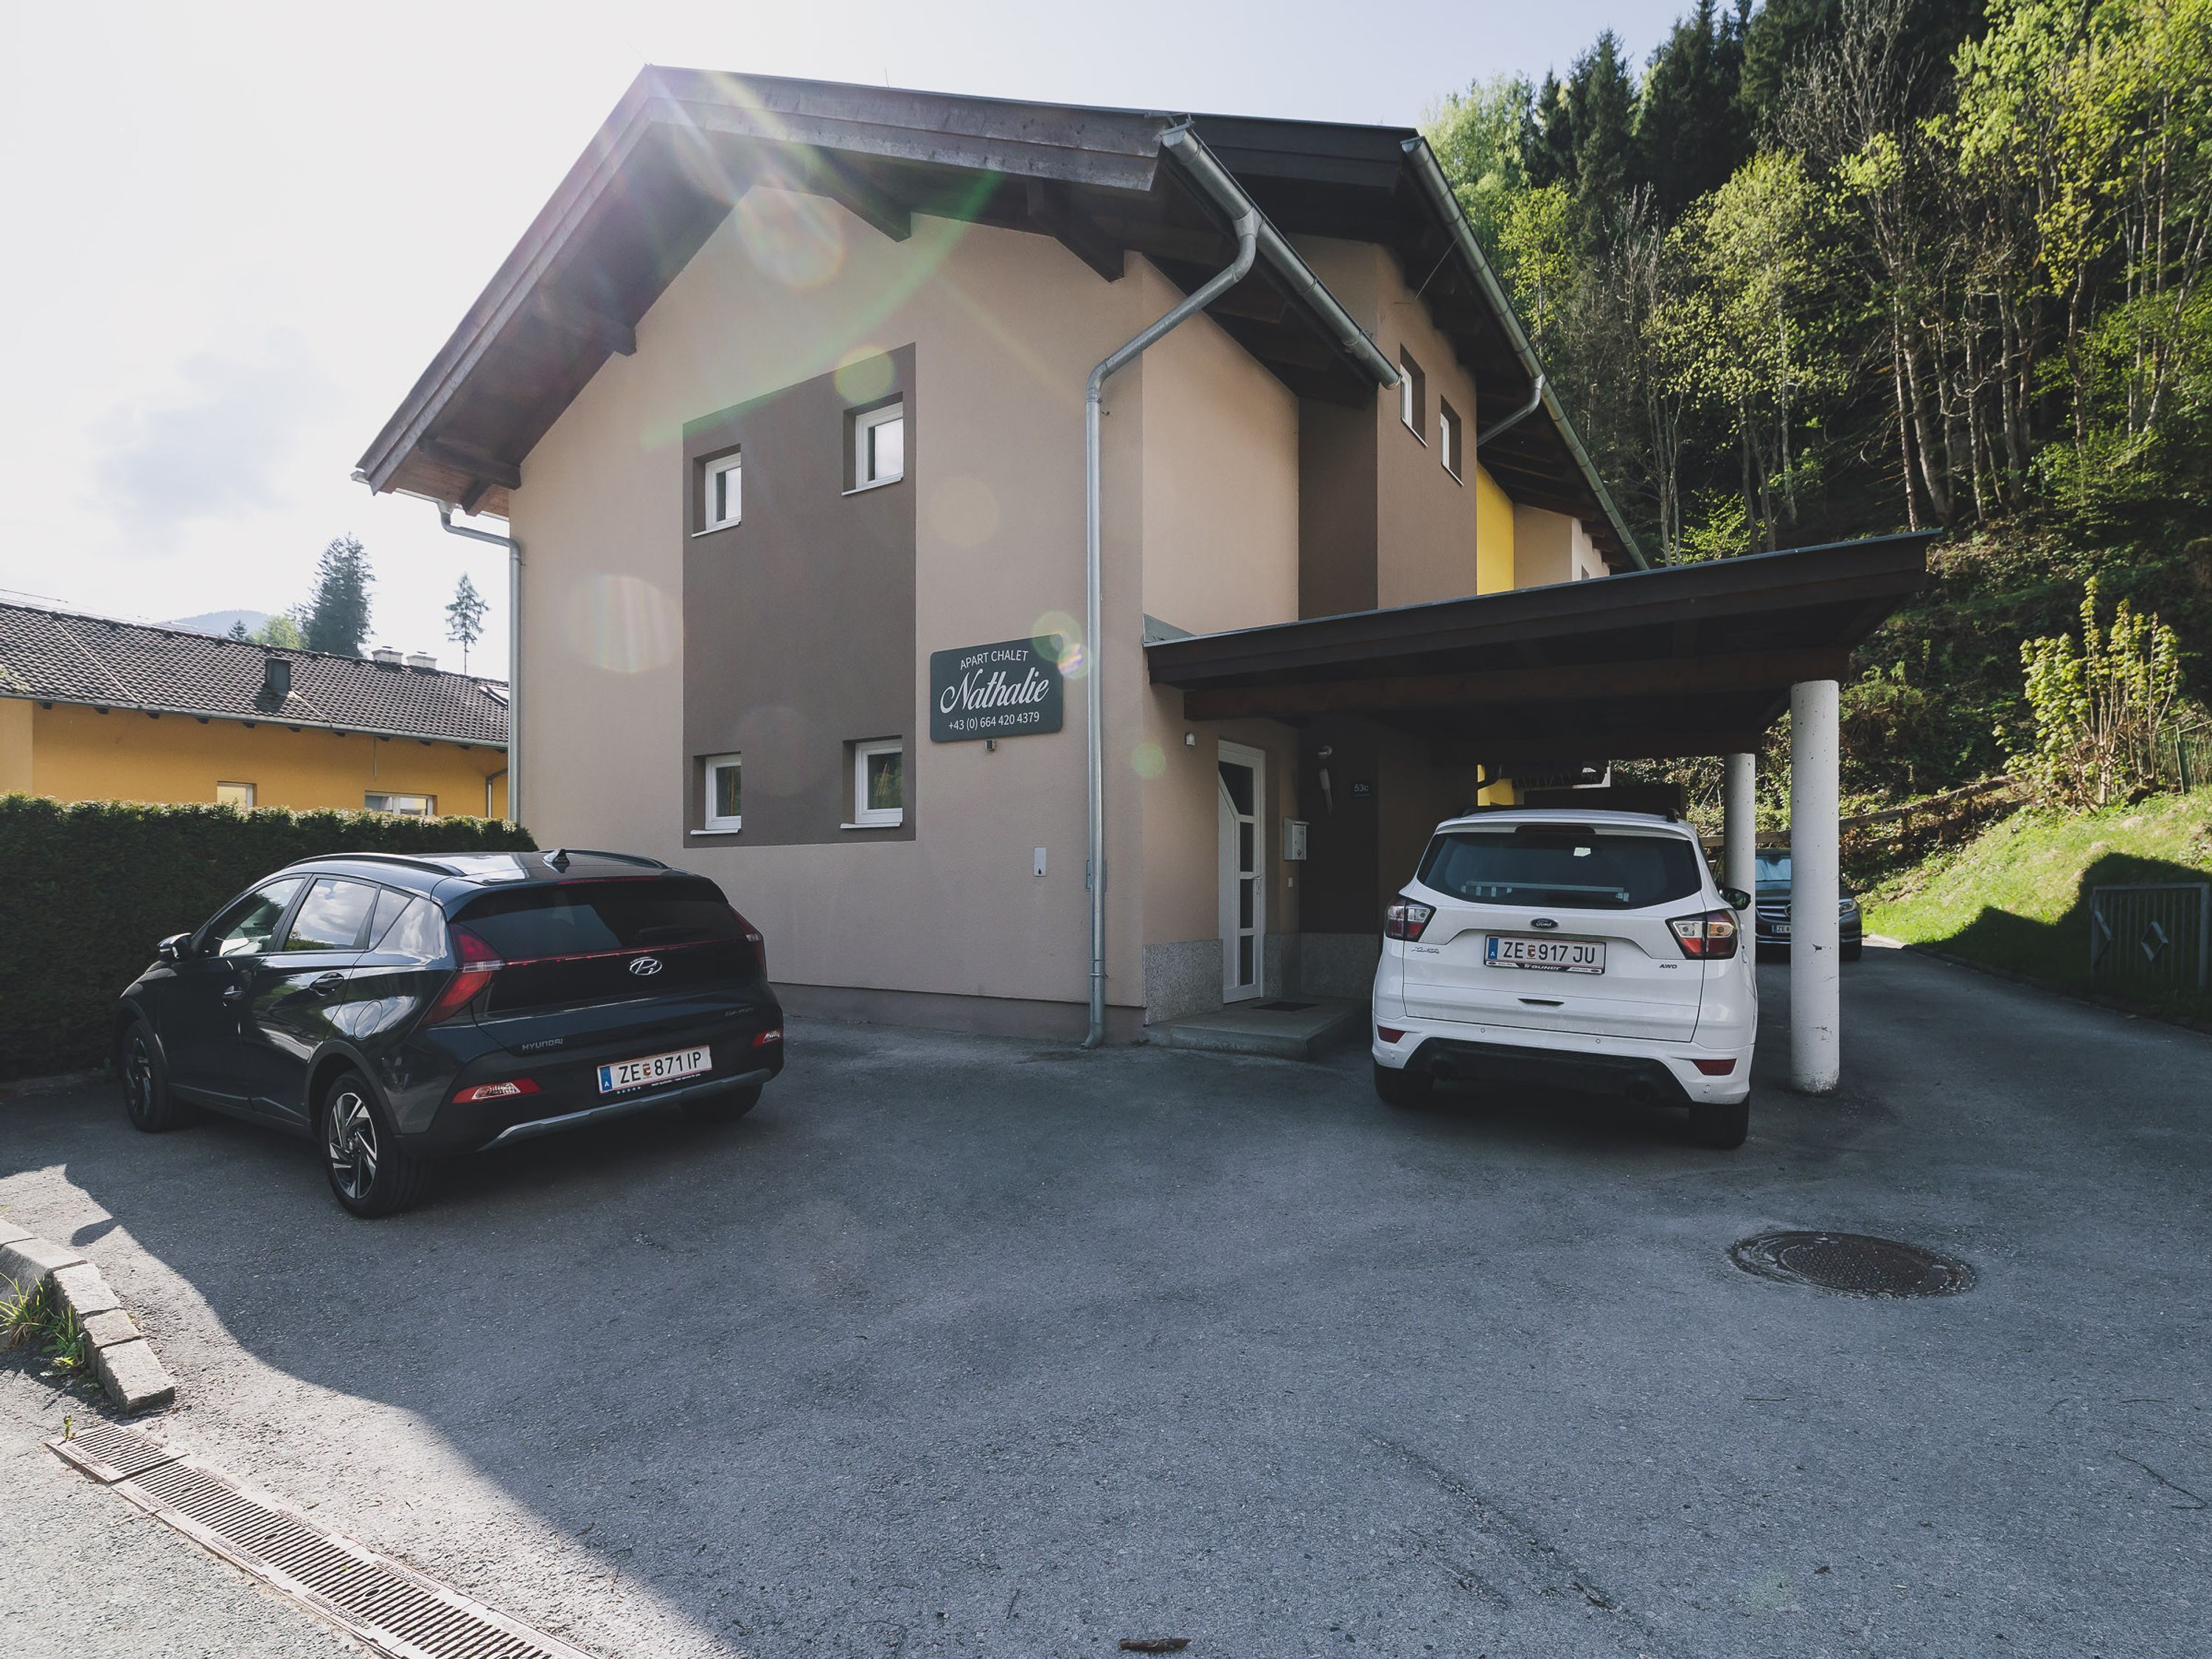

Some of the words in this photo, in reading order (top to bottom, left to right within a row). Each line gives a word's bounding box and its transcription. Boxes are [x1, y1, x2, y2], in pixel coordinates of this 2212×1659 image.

[960, 652, 989, 670] APART
[991, 650, 1029, 662] CHALET
[939, 667, 1049, 714] Nathalie
[948, 719, 964, 730] +43
[967, 717, 978, 731] (0)
[980, 717, 996, 728] 664
[998, 714, 1015, 726] 420
[1017, 711, 1040, 723] 4379
[1503, 942, 1524, 959] ZE
[1539, 944, 1568, 961] 917
[1573, 946, 1595, 964] JU
[522, 1038, 563, 1051] HYUNDAI
[619, 1063, 641, 1084] ZE
[654, 1055, 683, 1076] 871
